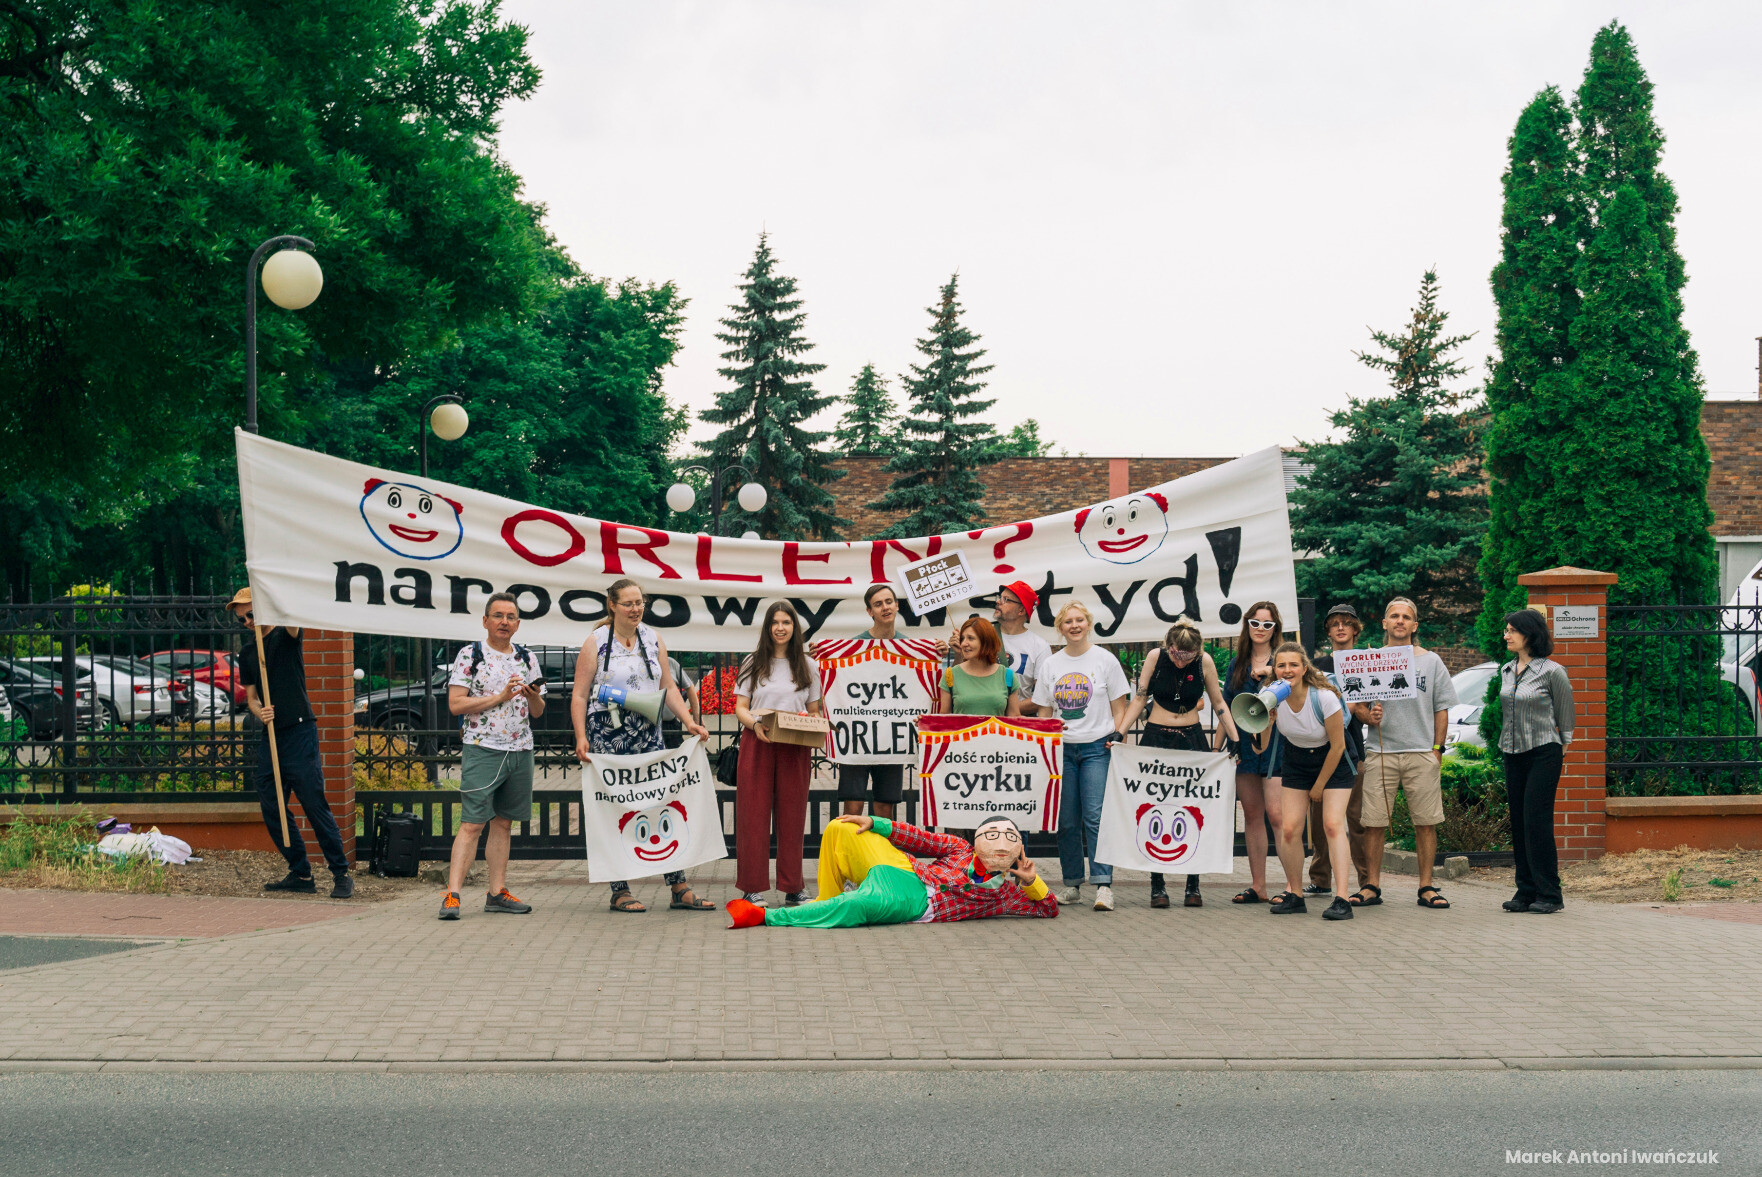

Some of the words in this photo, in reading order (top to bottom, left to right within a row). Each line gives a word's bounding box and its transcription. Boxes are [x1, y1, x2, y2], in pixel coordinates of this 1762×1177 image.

[501, 509, 1033, 585] ORLEN?
[1339, 660, 1372, 669] WYCINCE
[1373, 658, 1398, 667] DRZEW
[847, 675, 908, 705] cyrk
[1055, 674, 1089, 691] WE'RE
[833, 706, 928, 717] multienergetyczny
[944, 751, 977, 764] dość
[980, 751, 1037, 764] robienia
[602, 755, 688, 786] ORLEN?
[944, 765, 1032, 798] cyrku
[1138, 759, 1206, 782] witamy
[595, 787, 666, 803] narodowy
[669, 770, 700, 794] cyrk!
[1146, 779, 1221, 802] cyrku!
[943, 801, 950, 810] z
[953, 800, 1037, 815] transformacji
